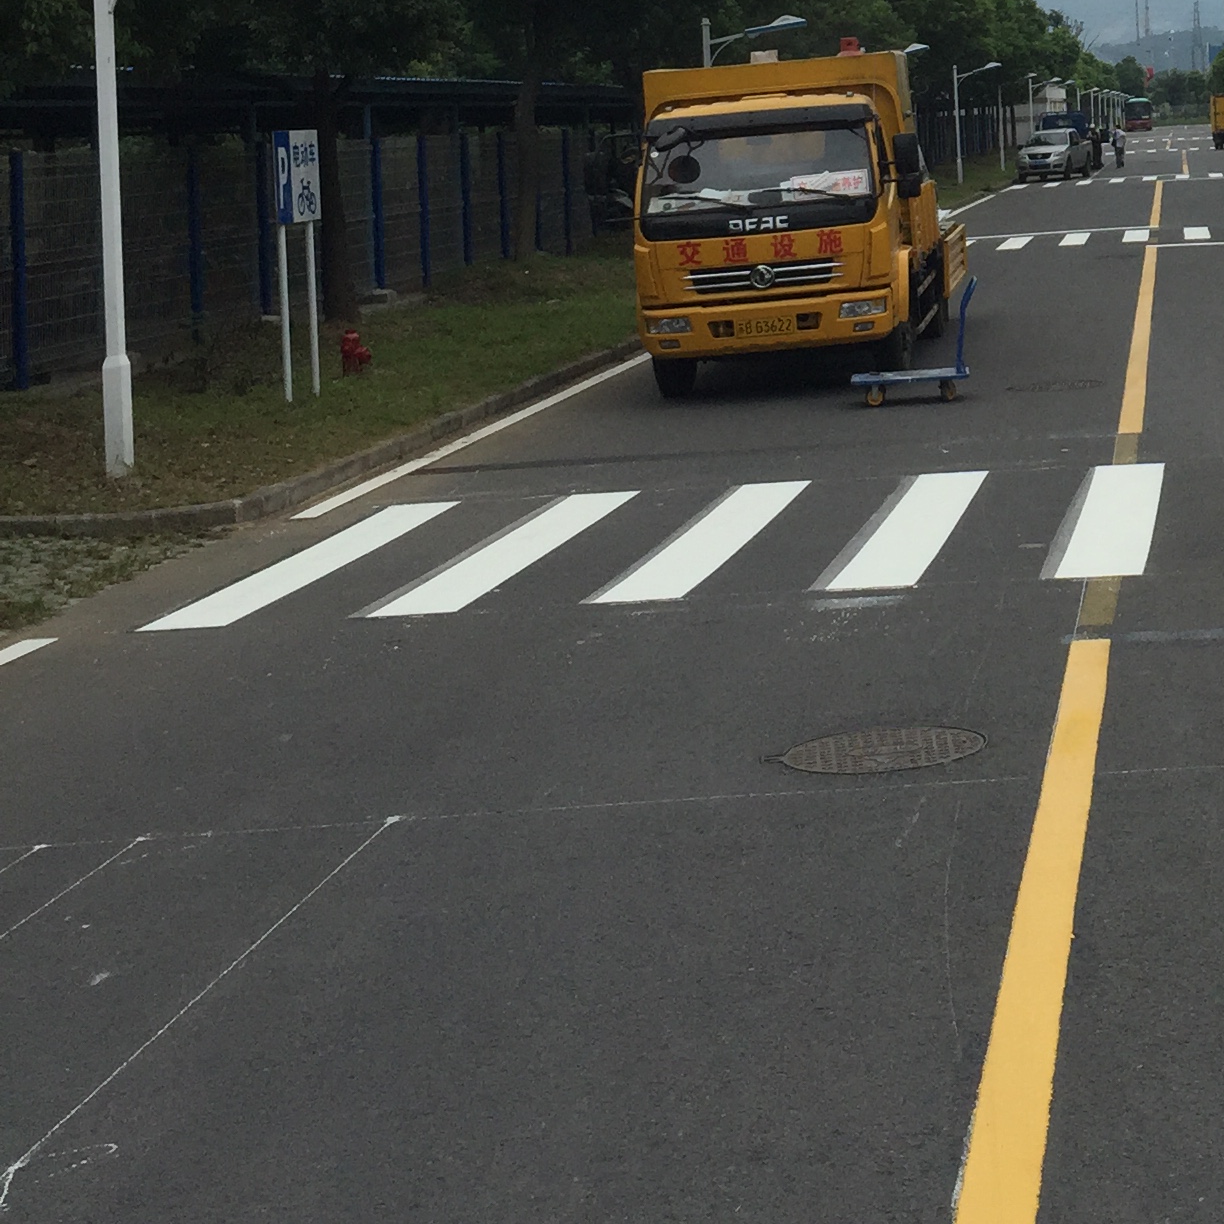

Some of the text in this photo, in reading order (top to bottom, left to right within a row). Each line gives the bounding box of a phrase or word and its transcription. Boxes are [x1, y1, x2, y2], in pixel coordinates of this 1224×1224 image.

[292, 141, 316, 167] 电动车
[277, 147, 289, 209] P
[677, 229, 844, 267] 交通设施
